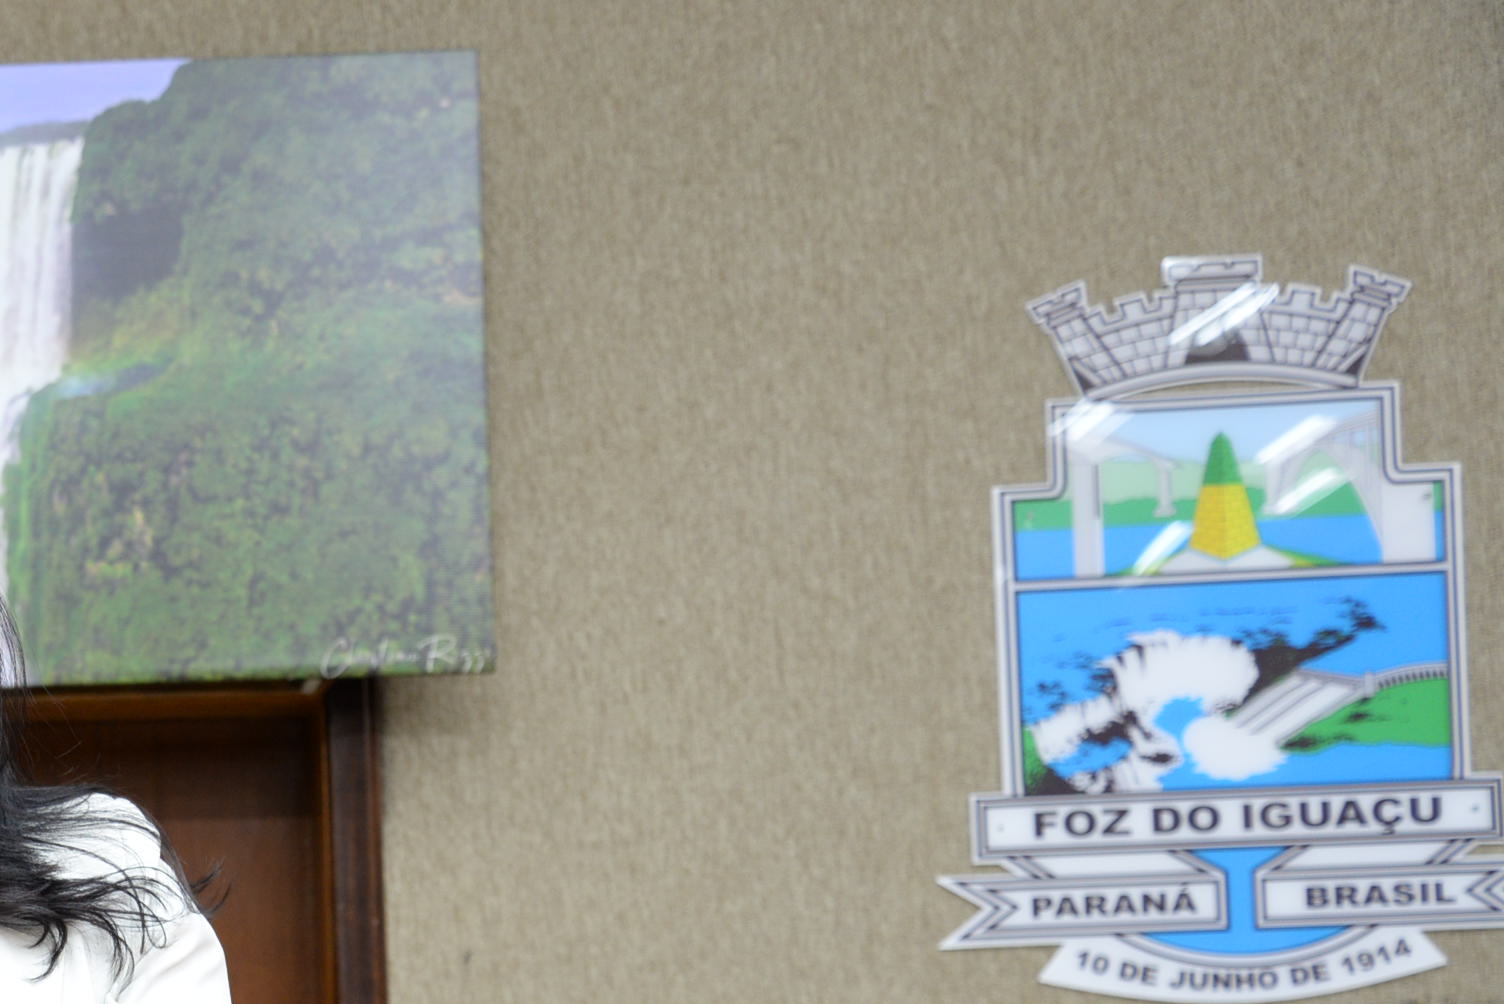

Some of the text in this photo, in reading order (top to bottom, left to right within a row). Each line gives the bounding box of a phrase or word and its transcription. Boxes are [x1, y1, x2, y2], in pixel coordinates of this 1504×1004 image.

[1033, 796, 1443, 838] FOZ DO IGUAÇU
[1031, 884, 1197, 917] PARANÁ
[1305, 882, 1455, 908] BRASIL
[1078, 938, 1413, 991] 10 DE JUNHO DE 1914
